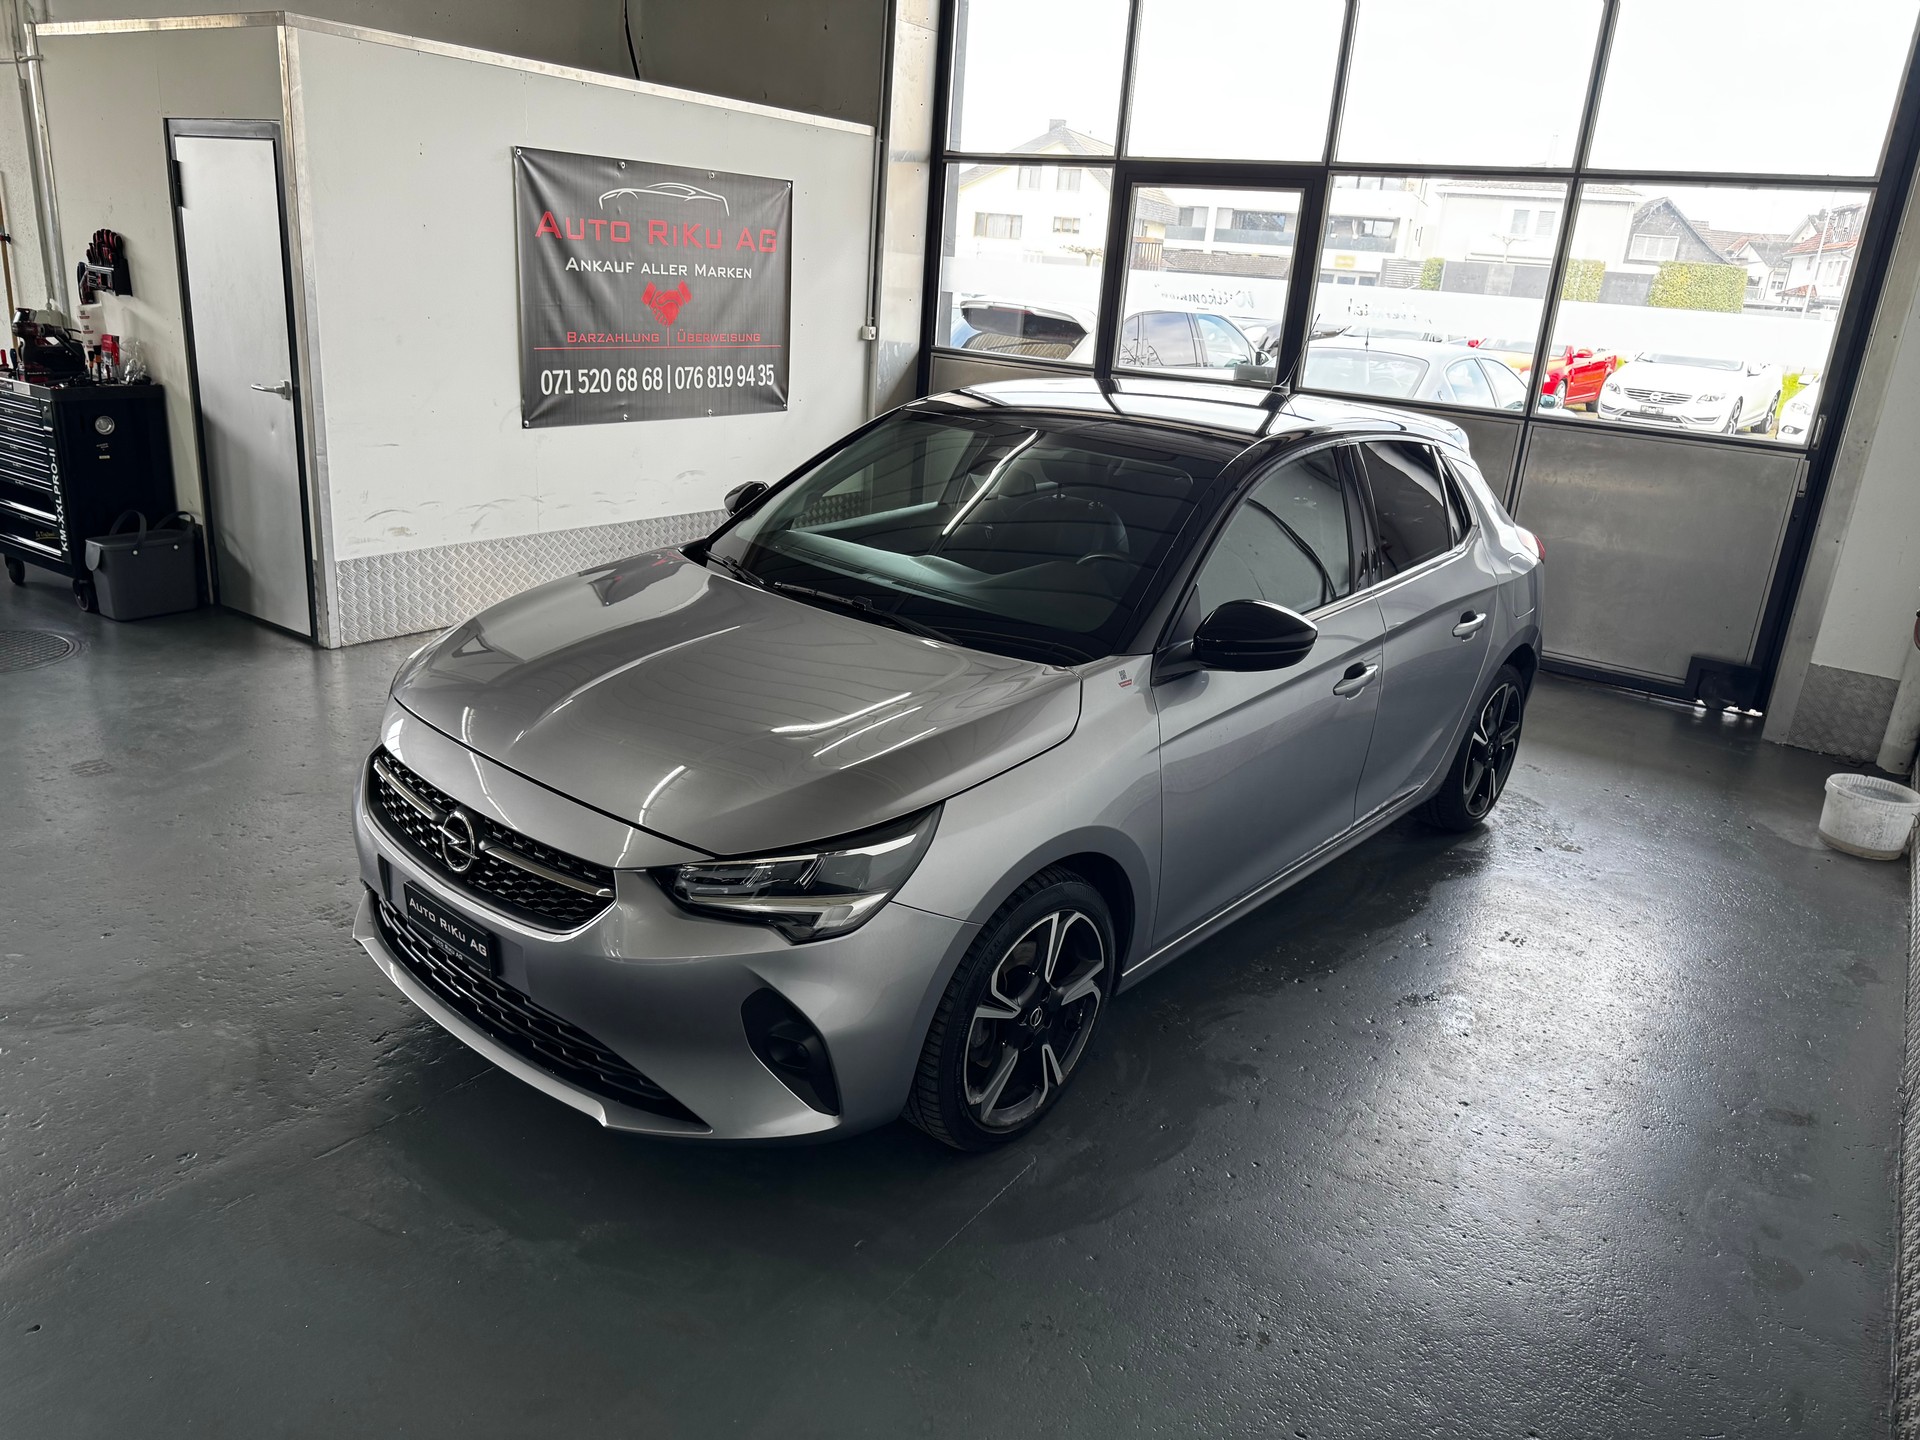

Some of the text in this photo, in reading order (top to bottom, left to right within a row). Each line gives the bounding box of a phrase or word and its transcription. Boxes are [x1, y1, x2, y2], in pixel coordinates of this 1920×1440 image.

[535, 211, 777, 252] AUTO RIKU AG
[565, 257, 752, 279] ANKAUF ALLER MARKEN
[566, 328, 761, 343] BARZAHLUNG ÜBERWEISUNG
[540, 363, 775, 396] 071 520 68 68 076 819 94 35
[409, 898, 487, 957] AUTO RIKU AG
